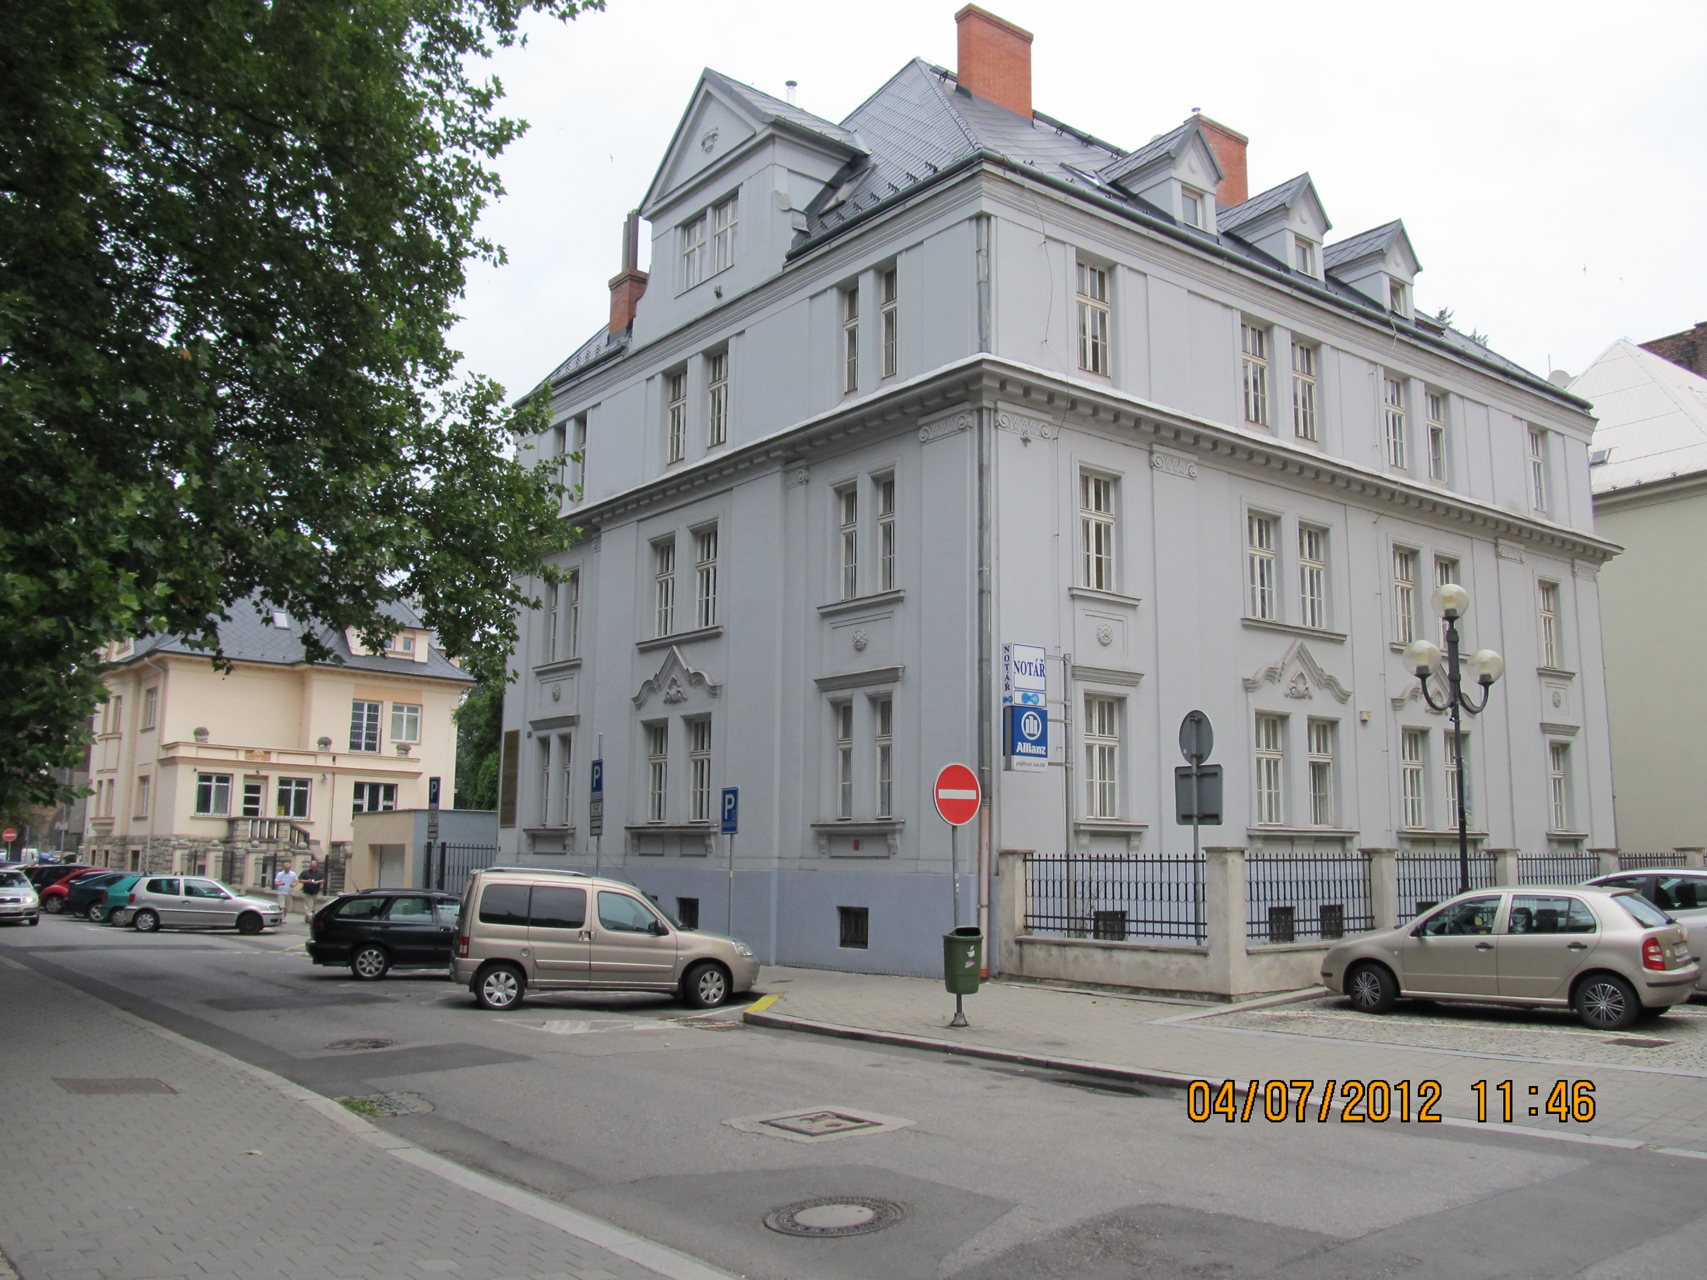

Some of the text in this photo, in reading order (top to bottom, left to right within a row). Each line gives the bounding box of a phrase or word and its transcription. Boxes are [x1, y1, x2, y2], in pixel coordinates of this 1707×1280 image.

[1013, 658, 1046, 677] NOTÁŘ
[1016, 742, 1047, 755] Allianz
[593, 765, 601, 788] P
[430, 781, 438, 799] P
[725, 794, 735, 819] P
